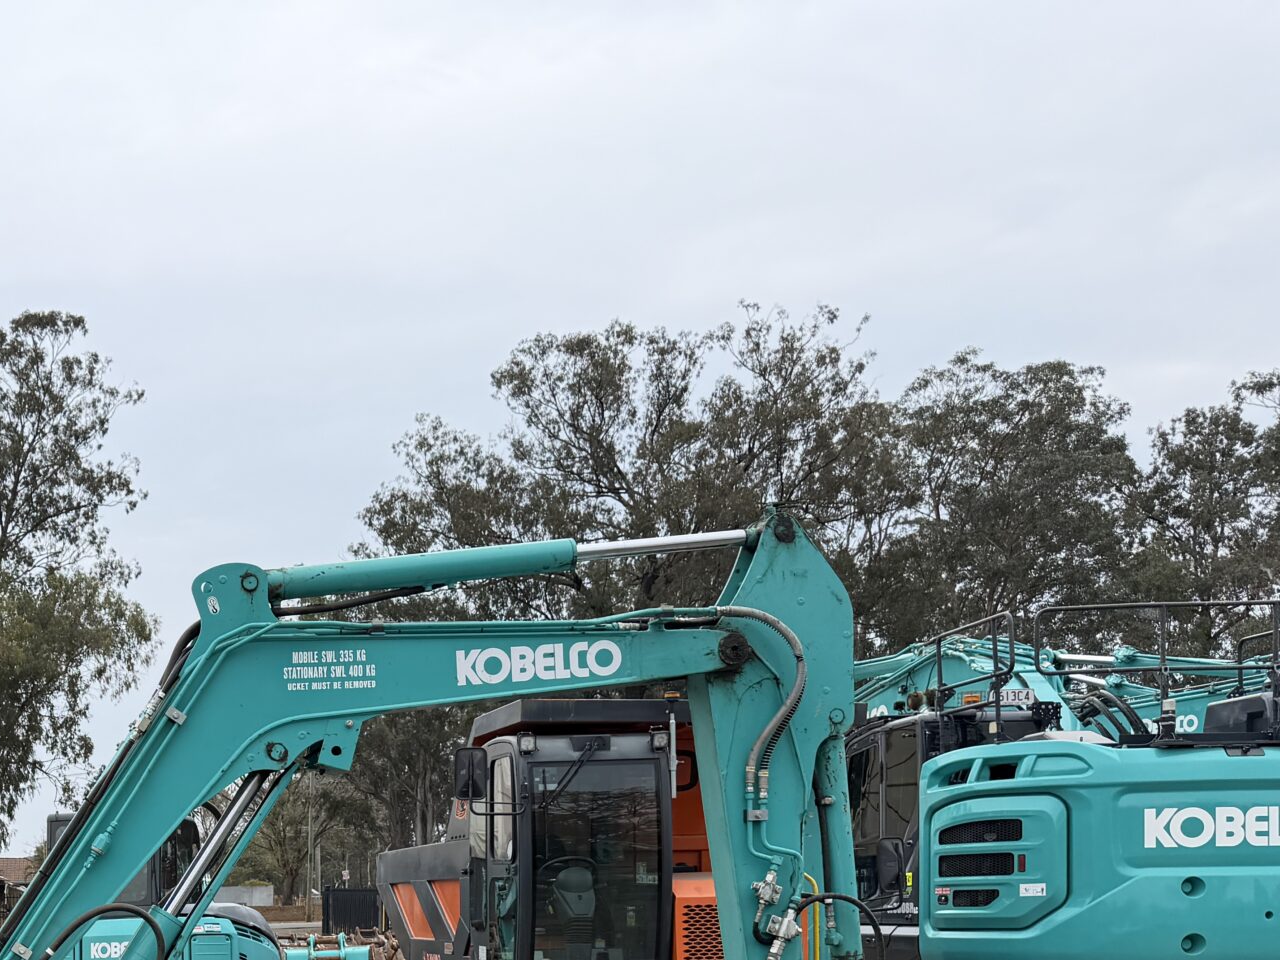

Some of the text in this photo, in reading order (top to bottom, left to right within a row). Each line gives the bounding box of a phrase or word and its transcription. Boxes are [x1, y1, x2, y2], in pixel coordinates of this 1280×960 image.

[292, 649, 366, 664] MOBILE SWL 335 KG
[455, 639, 622, 687] KOBELCO
[283, 664, 376, 680] STATIONARY SWL 400 KG
[311, 681, 330, 690] MUST
[333, 681, 342, 690] BE
[344, 680, 376, 689] REMOVED
[1144, 806, 1280, 849] KOBEL
